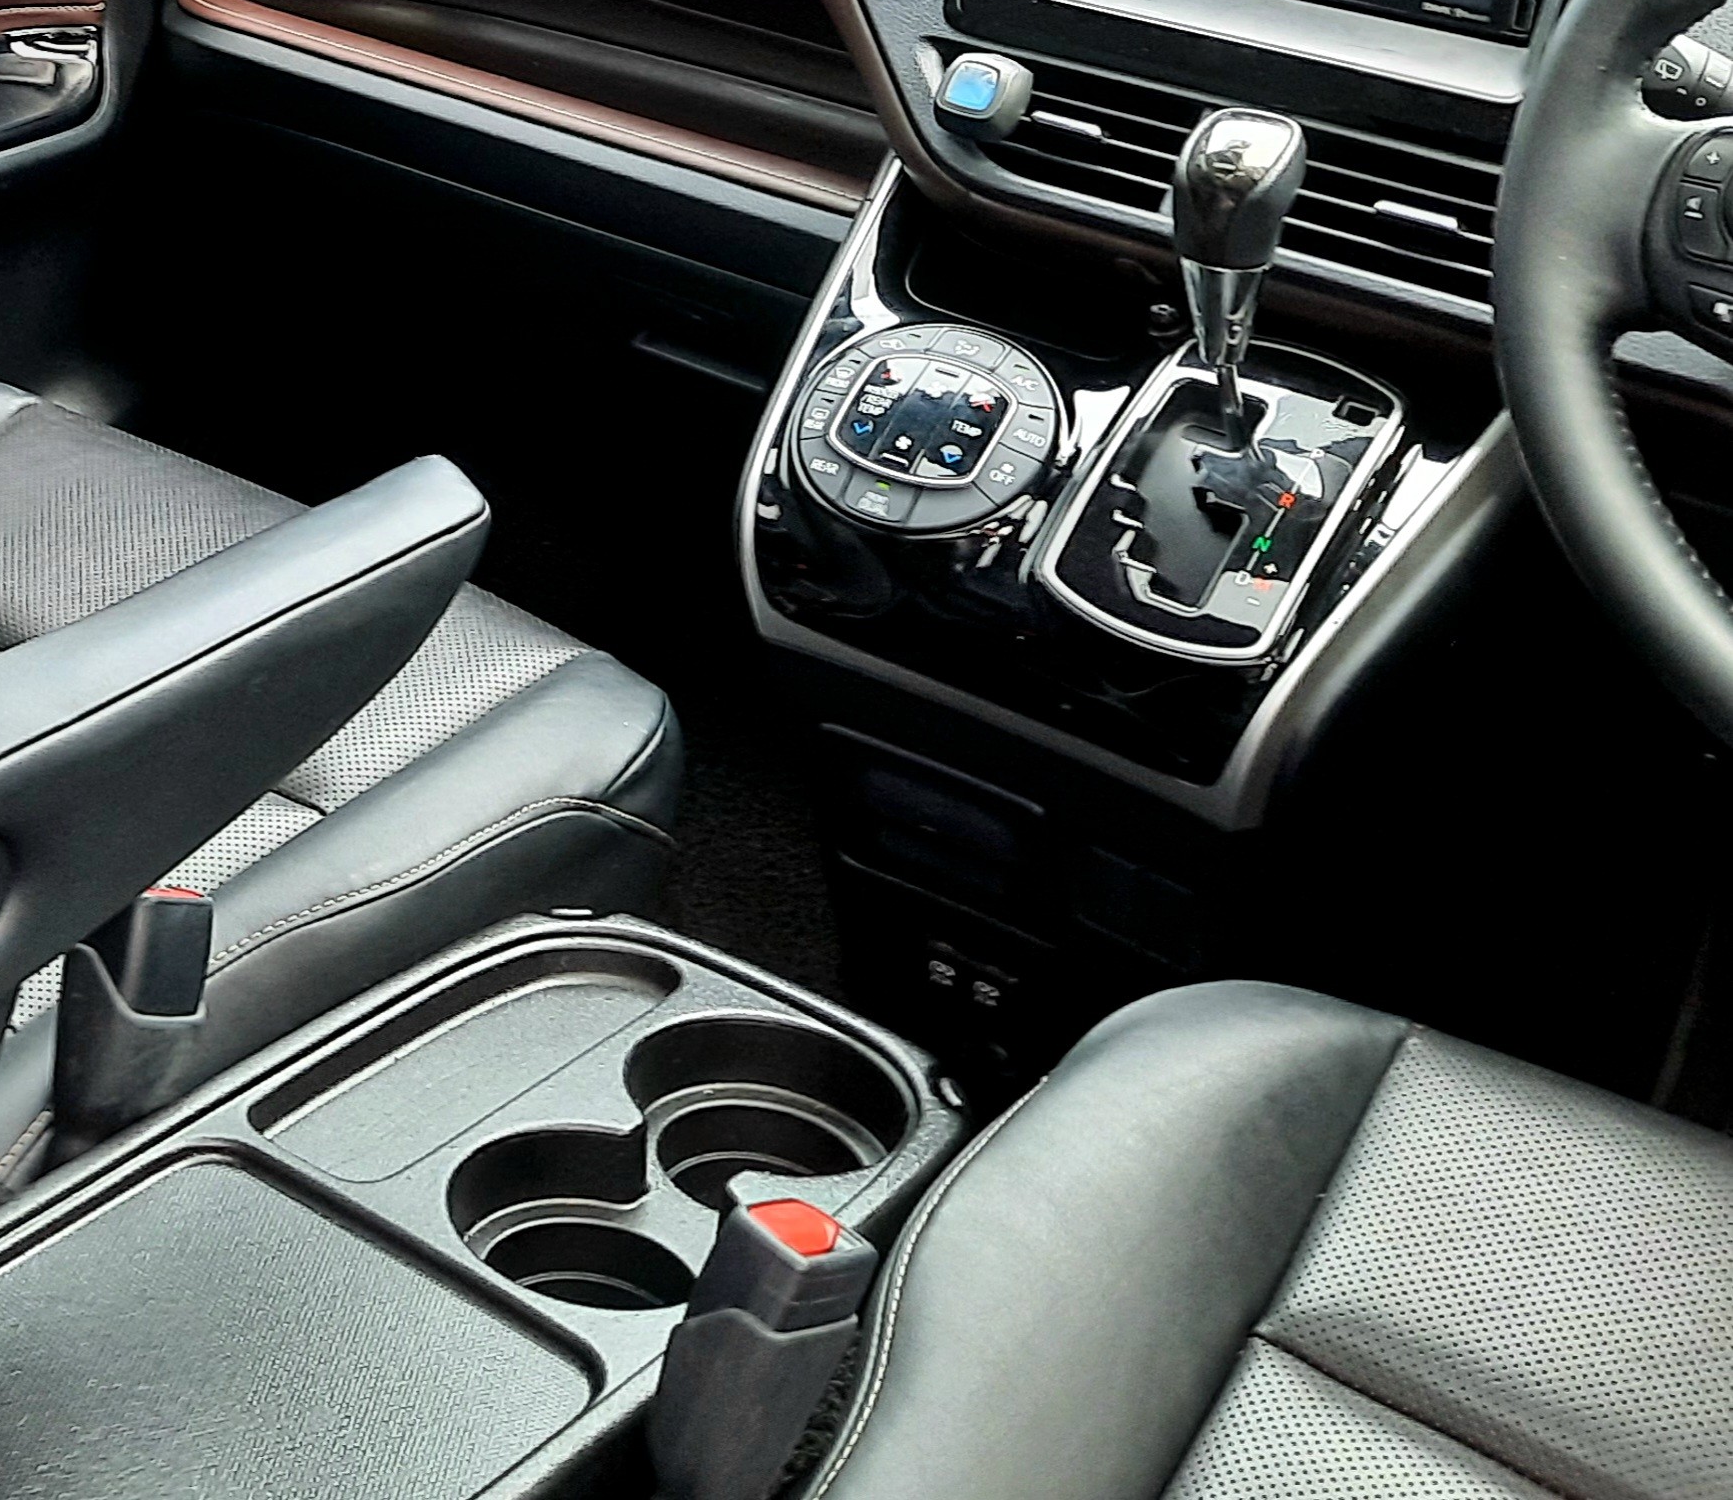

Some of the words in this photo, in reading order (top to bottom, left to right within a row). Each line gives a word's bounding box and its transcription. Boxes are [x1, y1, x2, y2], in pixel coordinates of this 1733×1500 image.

[952, 419, 983, 438] TEMP
[1012, 428, 1046, 448] AUTO
[989, 470, 1016, 487] OFF
[1278, 492, 1296, 509] R
[1252, 535, 1274, 553] N
